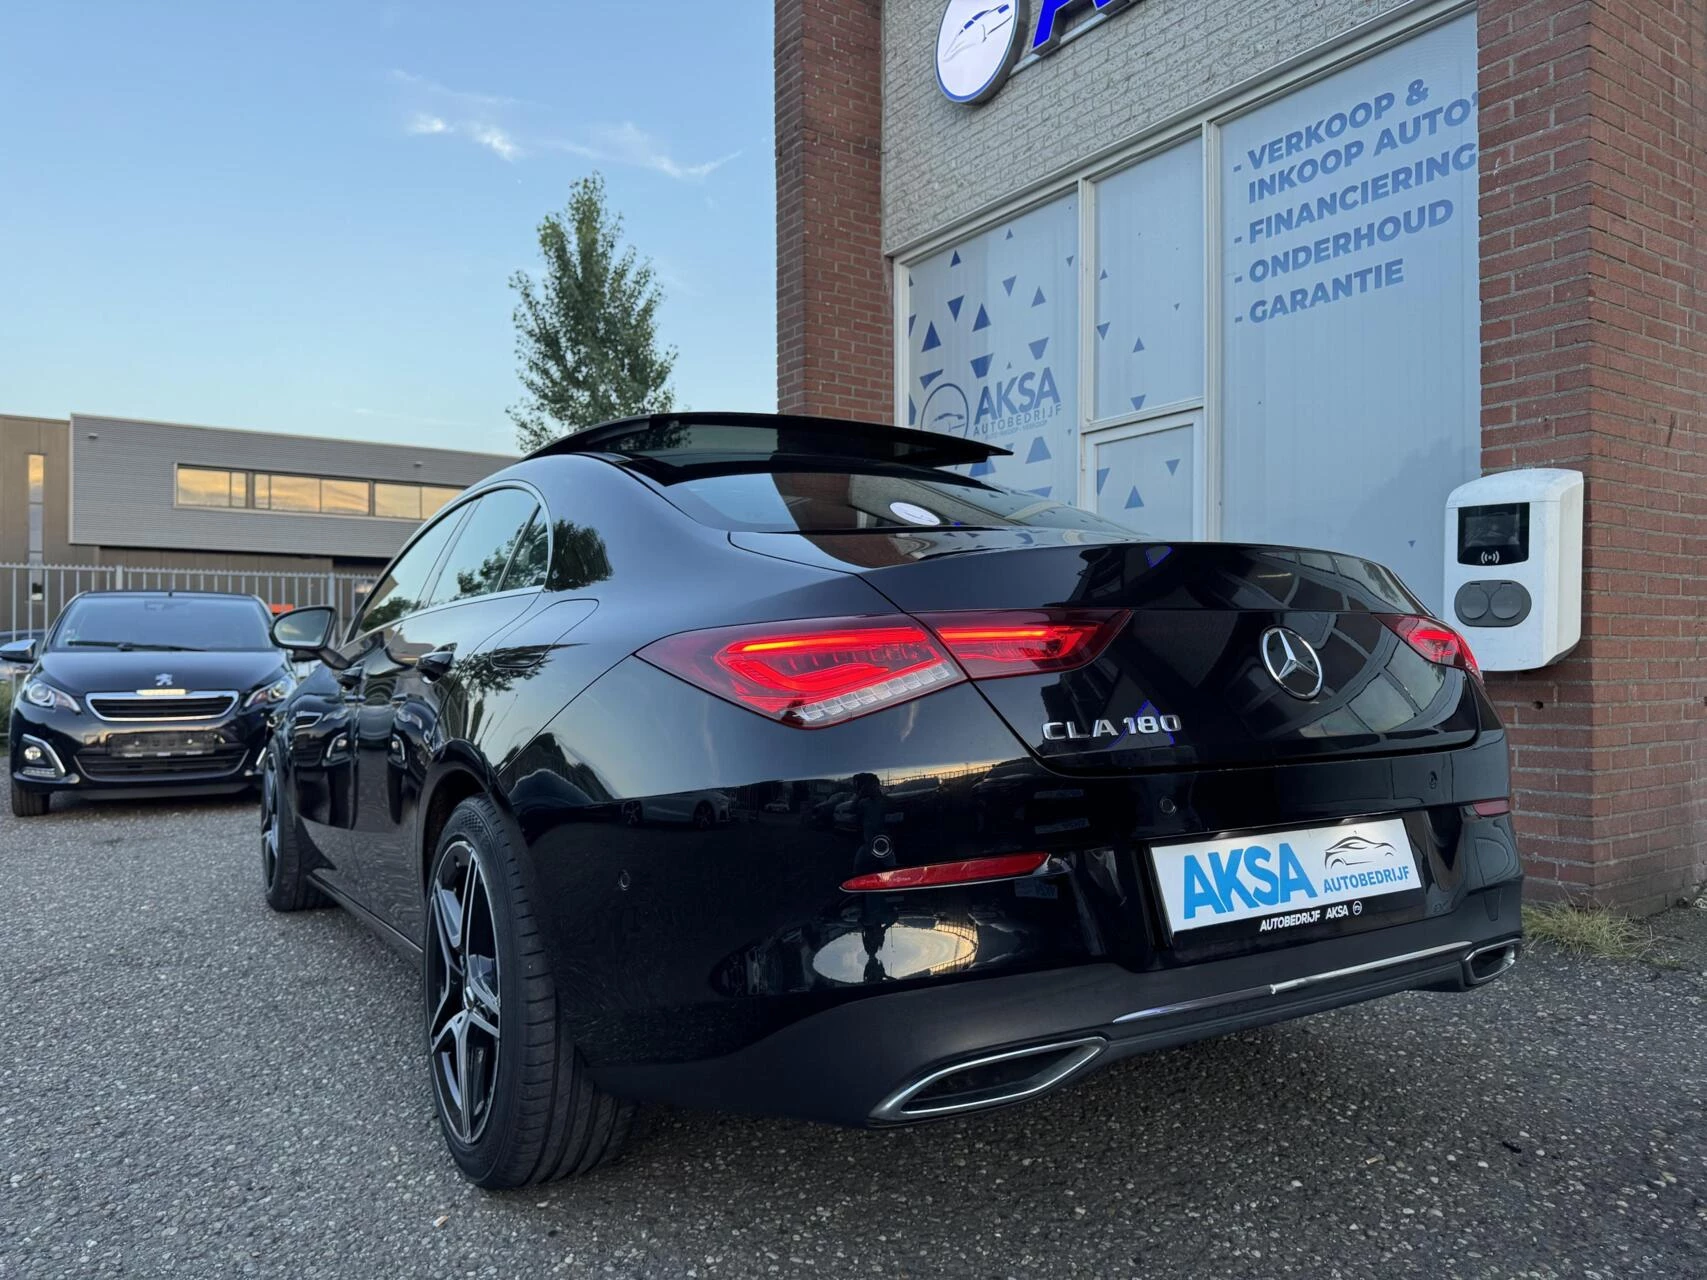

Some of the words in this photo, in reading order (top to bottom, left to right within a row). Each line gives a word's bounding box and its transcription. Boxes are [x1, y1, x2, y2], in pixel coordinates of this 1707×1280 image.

[1247, 92, 1395, 170] VERKOOP
[1405, 79, 1429, 107] &
[1249, 140, 1364, 204] INKOOP
[1249, 142, 1476, 245] FINANCIERING
[1249, 199, 1454, 283] ONDERHOUD
[1249, 258, 1404, 324] GARANTIE
[973, 366, 1061, 425] AKSA
[973, 403, 1062, 437] AUTOBEDRIJF
[1042, 719, 1119, 740] CLA
[1123, 714, 1182, 735] 180
[1183, 842, 1318, 920] AKSA
[1323, 866, 1410, 894] AUTOBEDRIJF
[1259, 911, 1321, 932] AUTOBEDRIJF
[1325, 905, 1349, 920] AKSA
